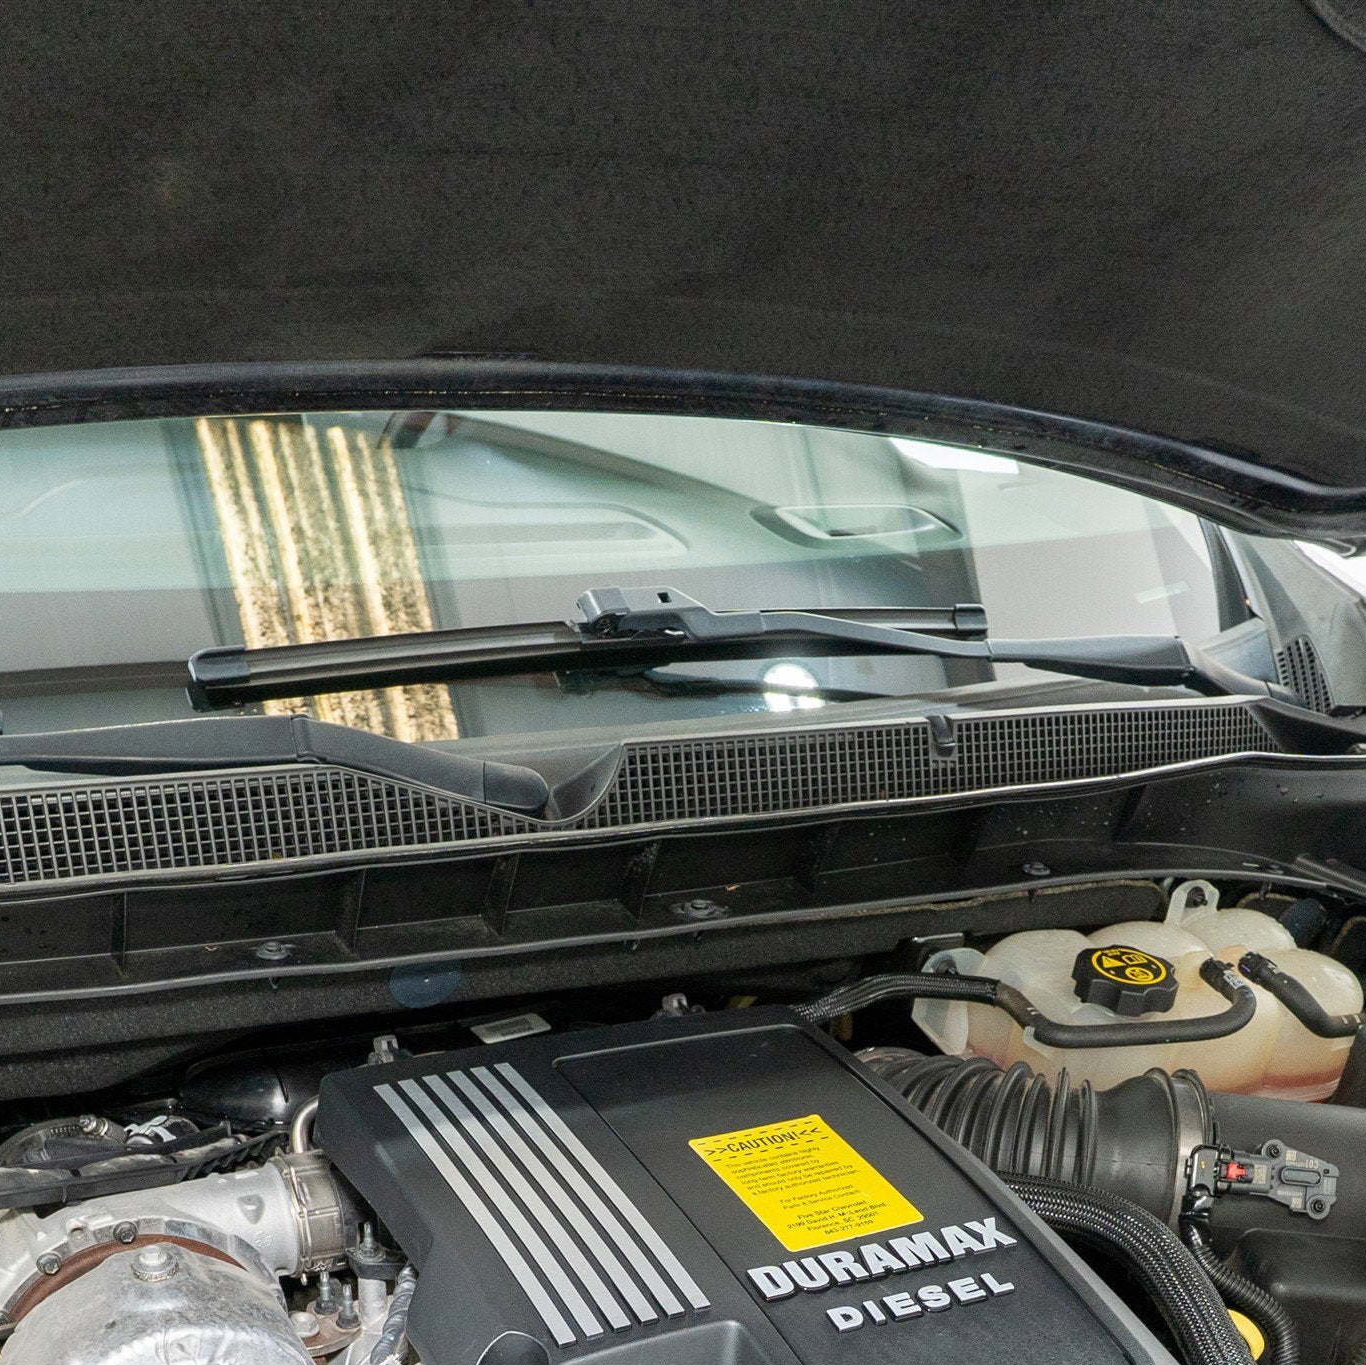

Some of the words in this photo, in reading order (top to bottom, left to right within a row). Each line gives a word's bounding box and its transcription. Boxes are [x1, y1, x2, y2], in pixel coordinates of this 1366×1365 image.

[806, 1216, 828, 1224] David
[831, 1200, 867, 1211] Chevrolet
[746, 1216, 1017, 1301] DURAMAX
[826, 1272, 1016, 1333] DIESEL
